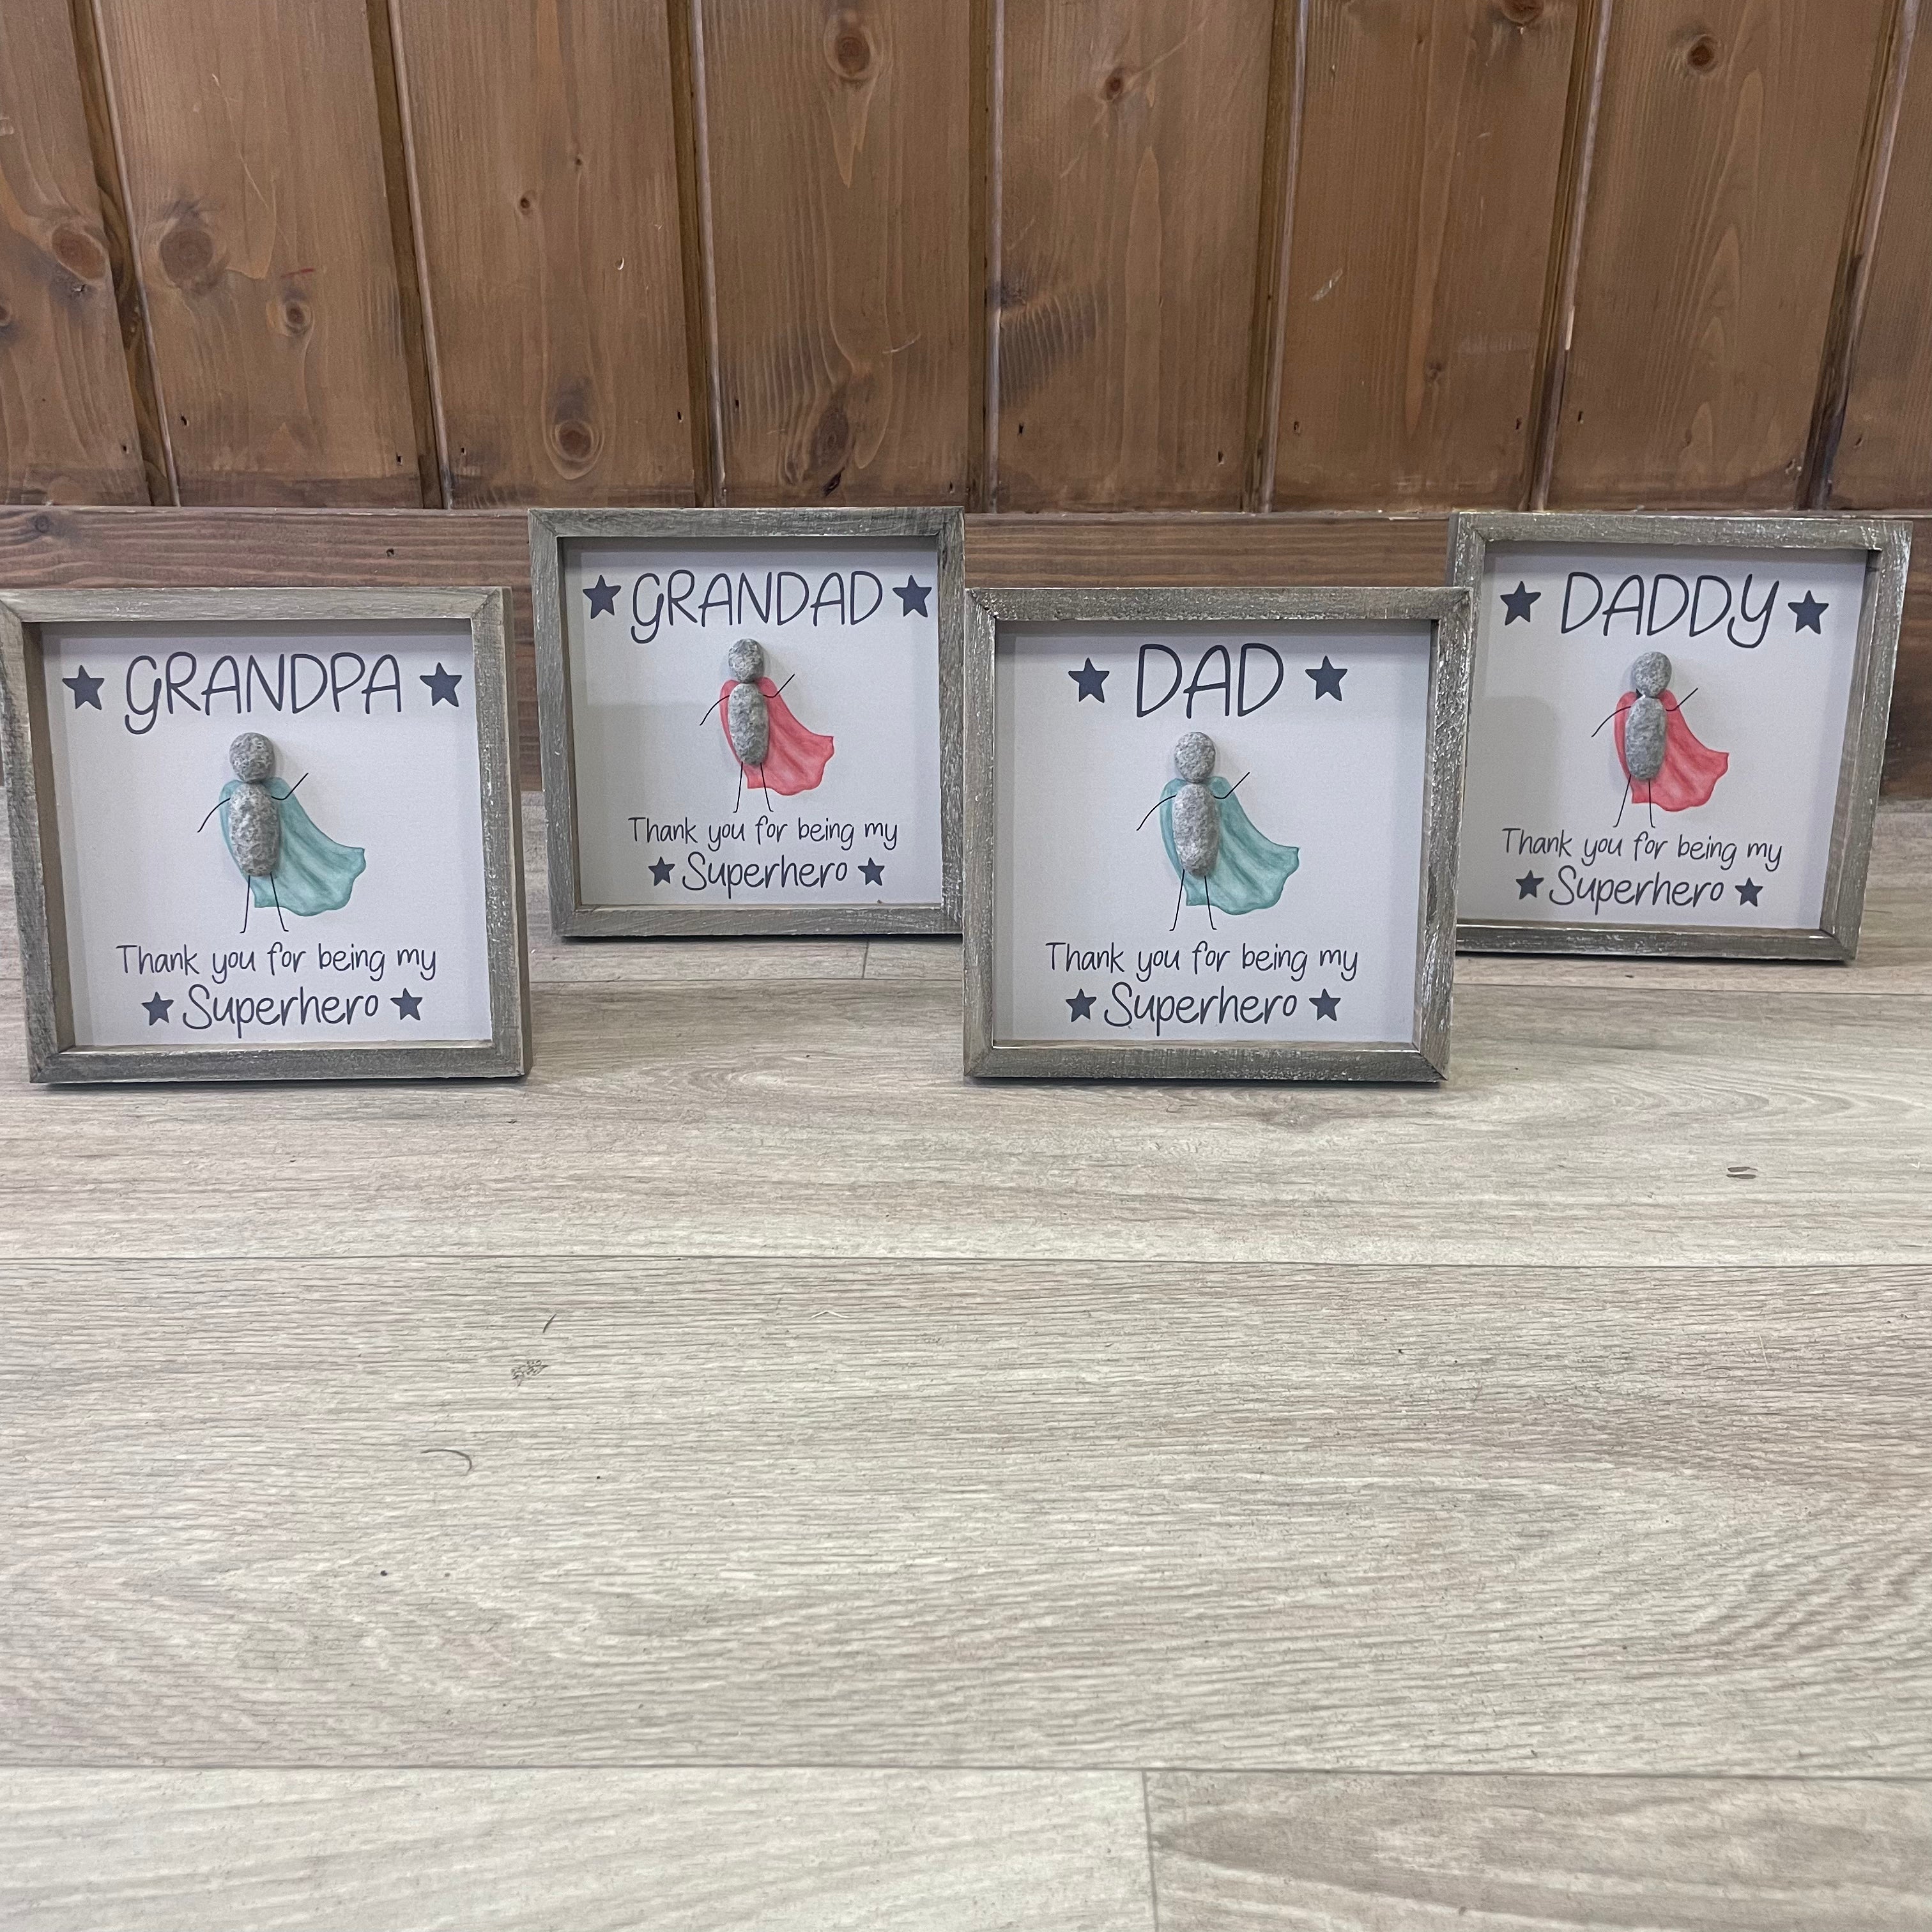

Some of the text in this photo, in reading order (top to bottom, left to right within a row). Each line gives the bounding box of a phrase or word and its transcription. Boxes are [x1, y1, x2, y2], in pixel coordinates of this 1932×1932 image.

[629, 569, 883, 644] GRANDAD
[1560, 571, 1779, 648] DADDY
[124, 652, 402, 735] GRANDPA
[1136, 643, 1284, 719] DAD
[627, 815, 898, 852] Thank you for being my
[1501, 827, 1782, 873] Thank you for being my
[682, 851, 848, 899] Superhero
[1549, 864, 1724, 915] Superhero
[115, 941, 436, 985] Thank you for being my
[1045, 940, 1358, 983] Thank you for being my
[182, 983, 379, 1039] Superhero
[1103, 981, 1298, 1037] Superhero
